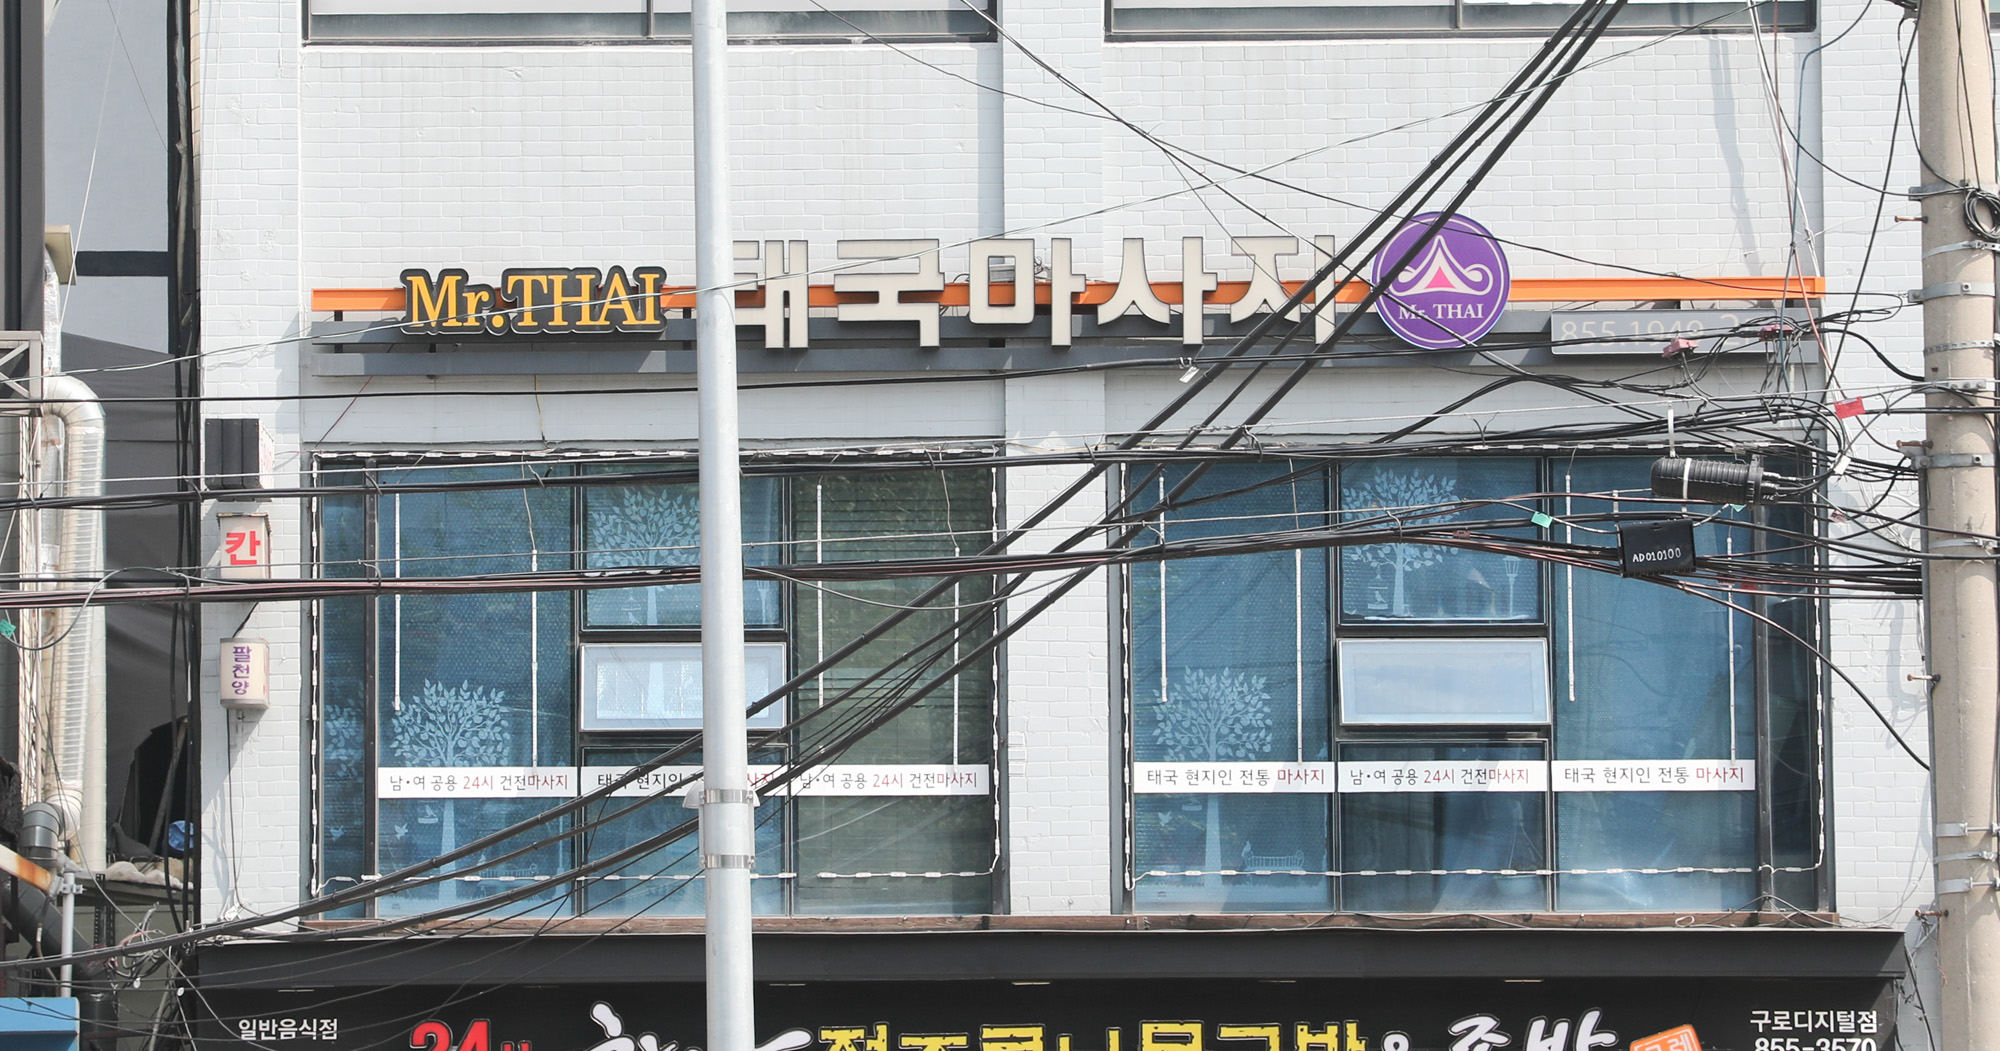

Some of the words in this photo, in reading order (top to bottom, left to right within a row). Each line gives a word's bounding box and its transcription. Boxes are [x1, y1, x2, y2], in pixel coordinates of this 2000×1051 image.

[733, 235, 1336, 349] 태국마사지
[1433, 303, 1484, 320] THAI
[225, 531, 261, 566] 칸
[1632, 547, 1682, 563] AD010100
[231, 645, 252, 696] 팔천양
[430, 775, 458, 791] 공용
[463, 775, 493, 790] 24시
[840, 773, 868, 790] 공용
[872, 773, 903, 788] 24시
[1147, 769, 1179, 786] 태국
[1185, 769, 1232, 786] 현지인
[1239, 769, 1271, 787] 전통
[1277, 768, 1325, 785] 마사지
[1391, 768, 1419, 786] 공용
[1423, 768, 1455, 784] 24시
[1564, 767, 1596, 784] 태국
[1603, 767, 1650, 784] 현지인
[1657, 767, 1690, 784] 전통
[1696, 766, 1744, 784] 마사지
[237, 1018, 338, 1041] 일반음식점
[1749, 1009, 1878, 1033] 구로디지털점
